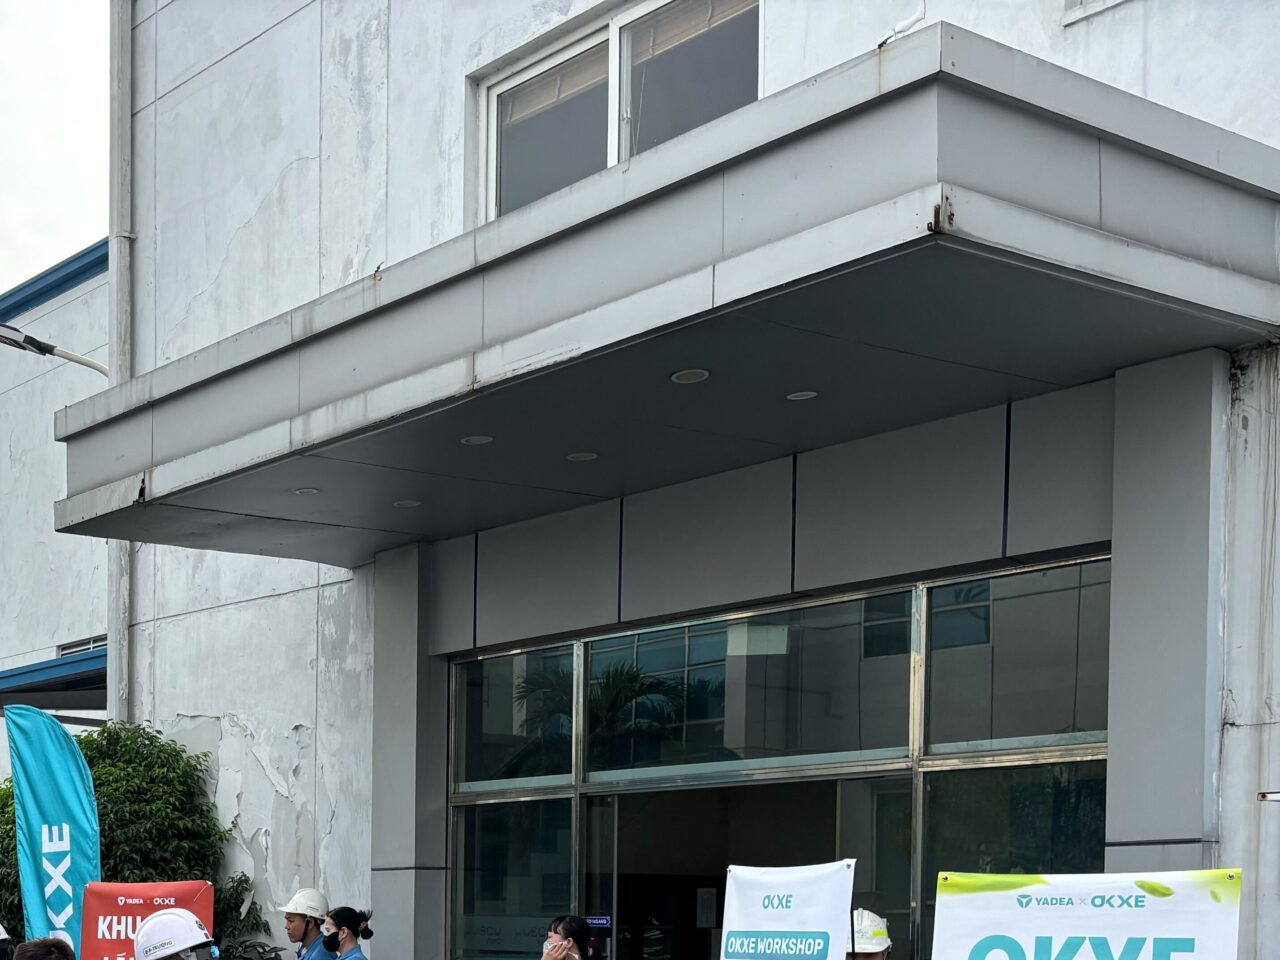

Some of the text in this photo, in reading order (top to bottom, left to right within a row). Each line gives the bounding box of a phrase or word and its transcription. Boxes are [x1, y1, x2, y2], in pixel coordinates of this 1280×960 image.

[1035, 896, 1074, 907] YADEA
[1090, 894, 1146, 909] OKXE
[727, 937, 825, 956] OKXE WORKSHOP
